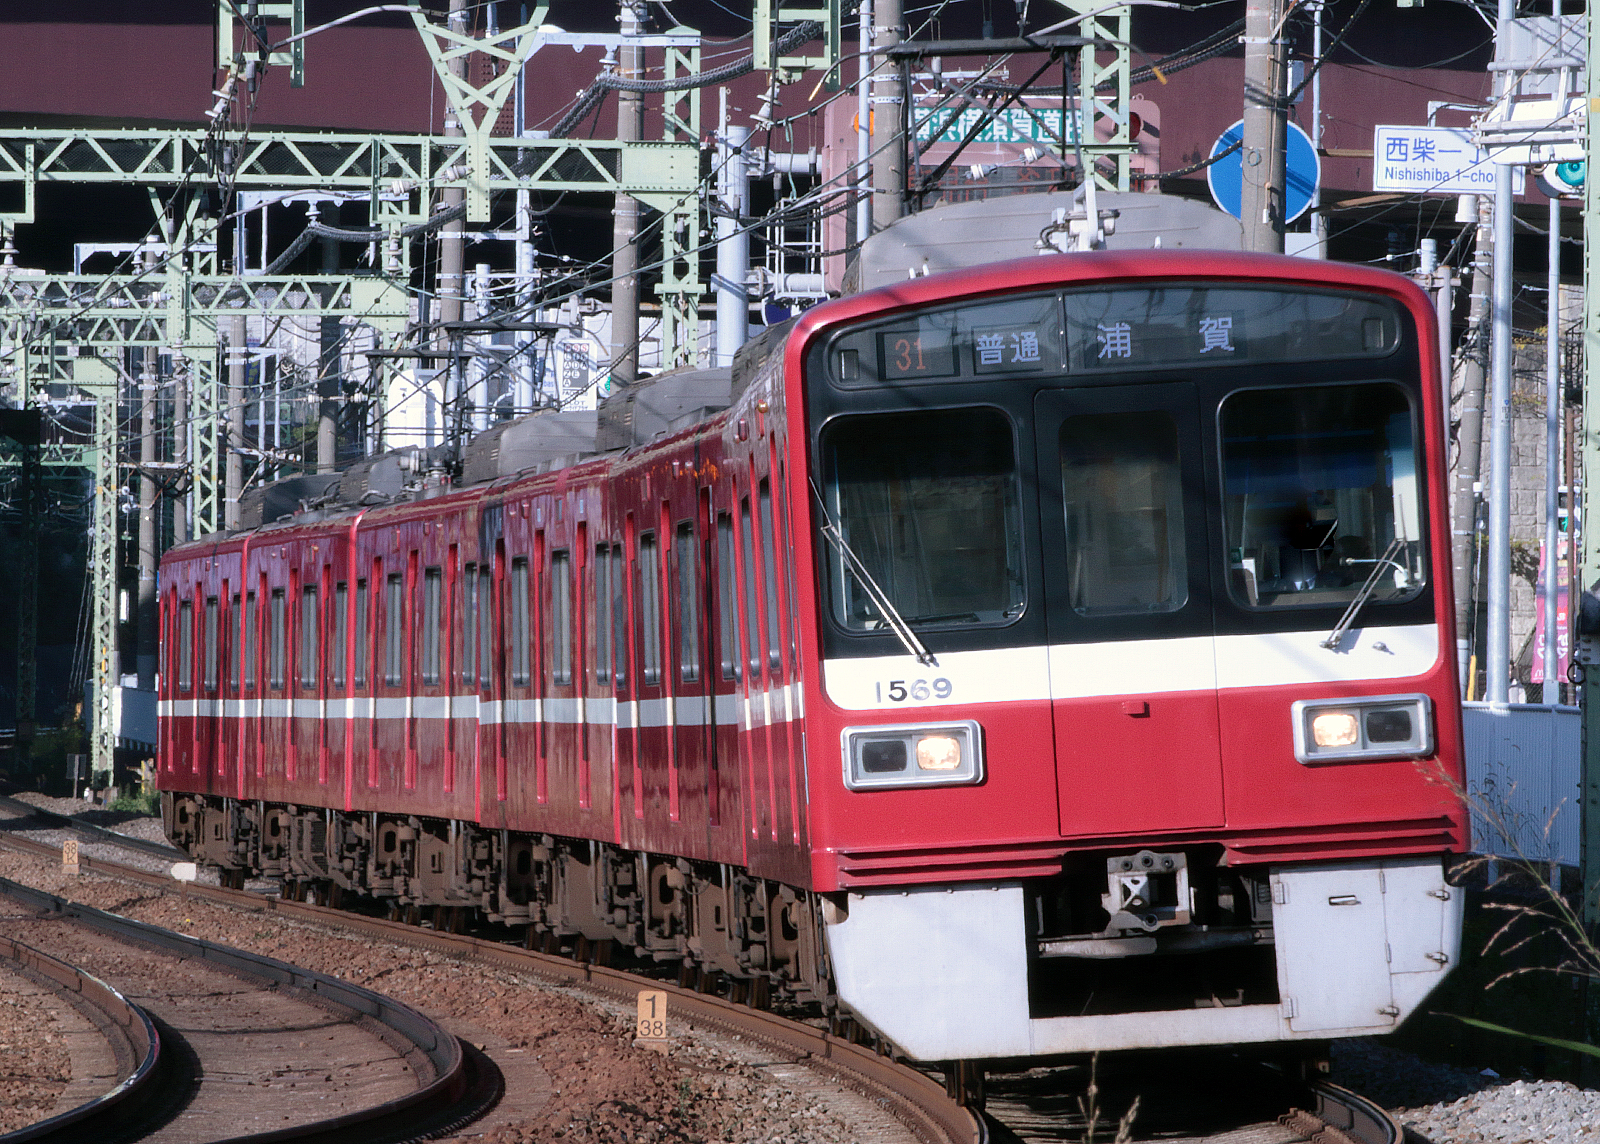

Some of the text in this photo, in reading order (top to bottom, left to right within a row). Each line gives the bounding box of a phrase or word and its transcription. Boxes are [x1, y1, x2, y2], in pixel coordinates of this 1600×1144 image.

[1385, 166, 1497, 183] Nishishiba 1-cho
[895, 338, 926, 371] 31
[976, 331, 1041, 365] 普通
[875, 677, 953, 703] 1569
[65, 842, 77, 854] 38
[645, 994, 656, 1019] 1
[640, 1020, 663, 1036] 38
